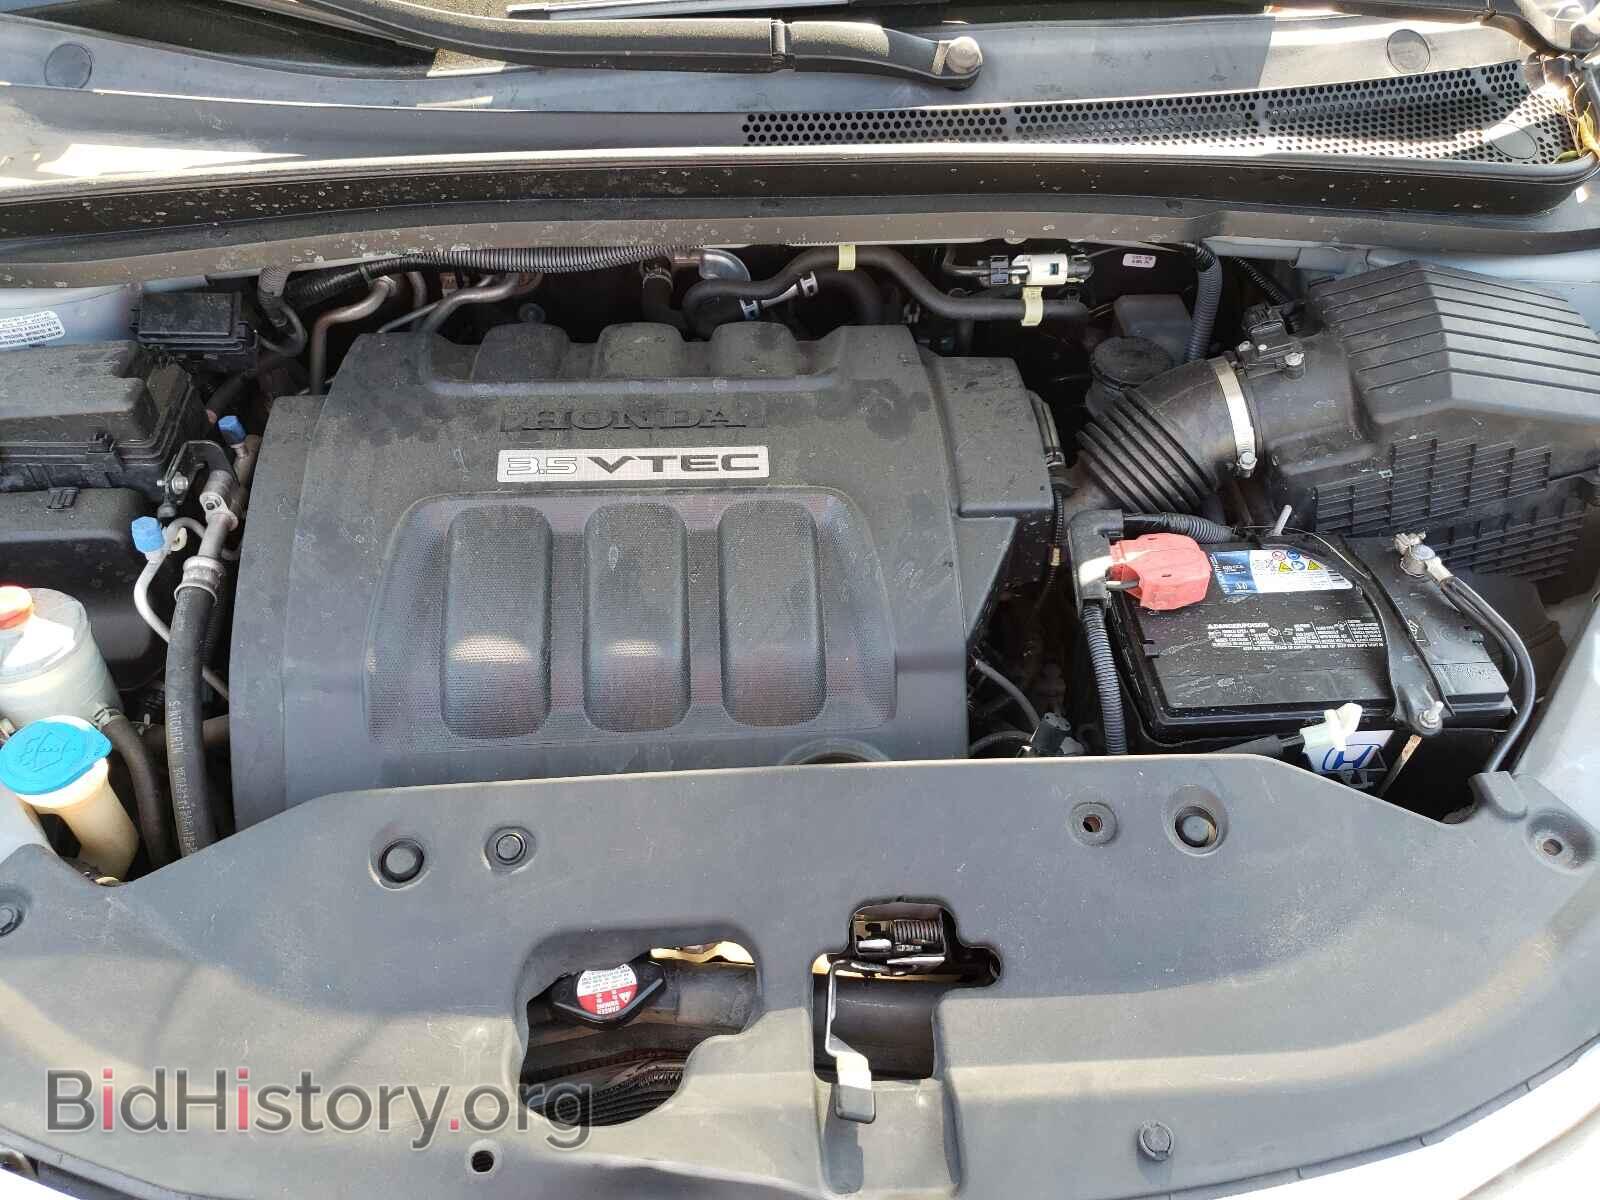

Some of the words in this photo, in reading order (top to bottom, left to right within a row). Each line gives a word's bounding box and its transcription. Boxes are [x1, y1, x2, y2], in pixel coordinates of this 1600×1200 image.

[519, 408, 747, 431] HONDA
[507, 456, 578, 476] 3.5
[586, 453, 760, 475] VTEC
